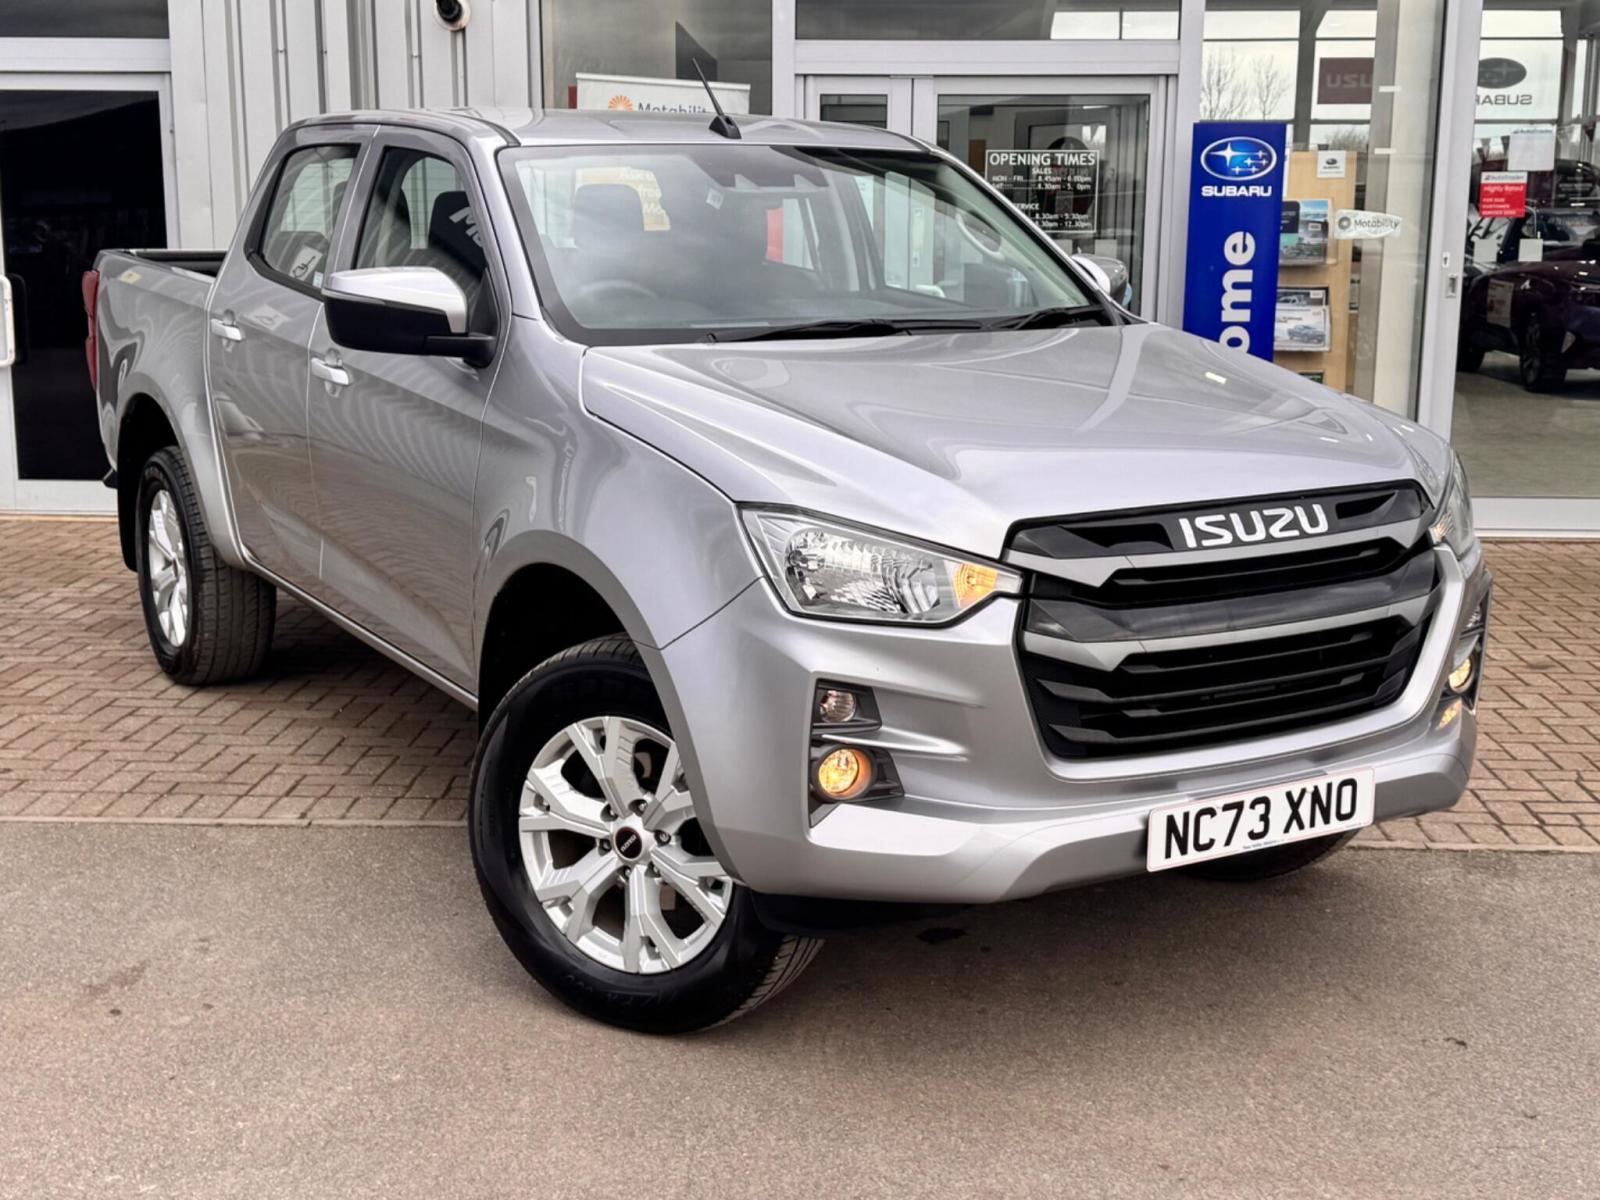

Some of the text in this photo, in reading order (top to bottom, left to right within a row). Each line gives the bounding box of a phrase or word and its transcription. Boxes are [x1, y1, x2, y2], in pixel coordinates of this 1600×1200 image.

[989, 153, 1096, 166] OPENING TIMES
[1032, 167, 1052, 175] SALES
[1201, 185, 1272, 197] SUBARU
[1179, 504, 1328, 548] ISUZU
[1165, 778, 1357, 859] NC73 XNO
